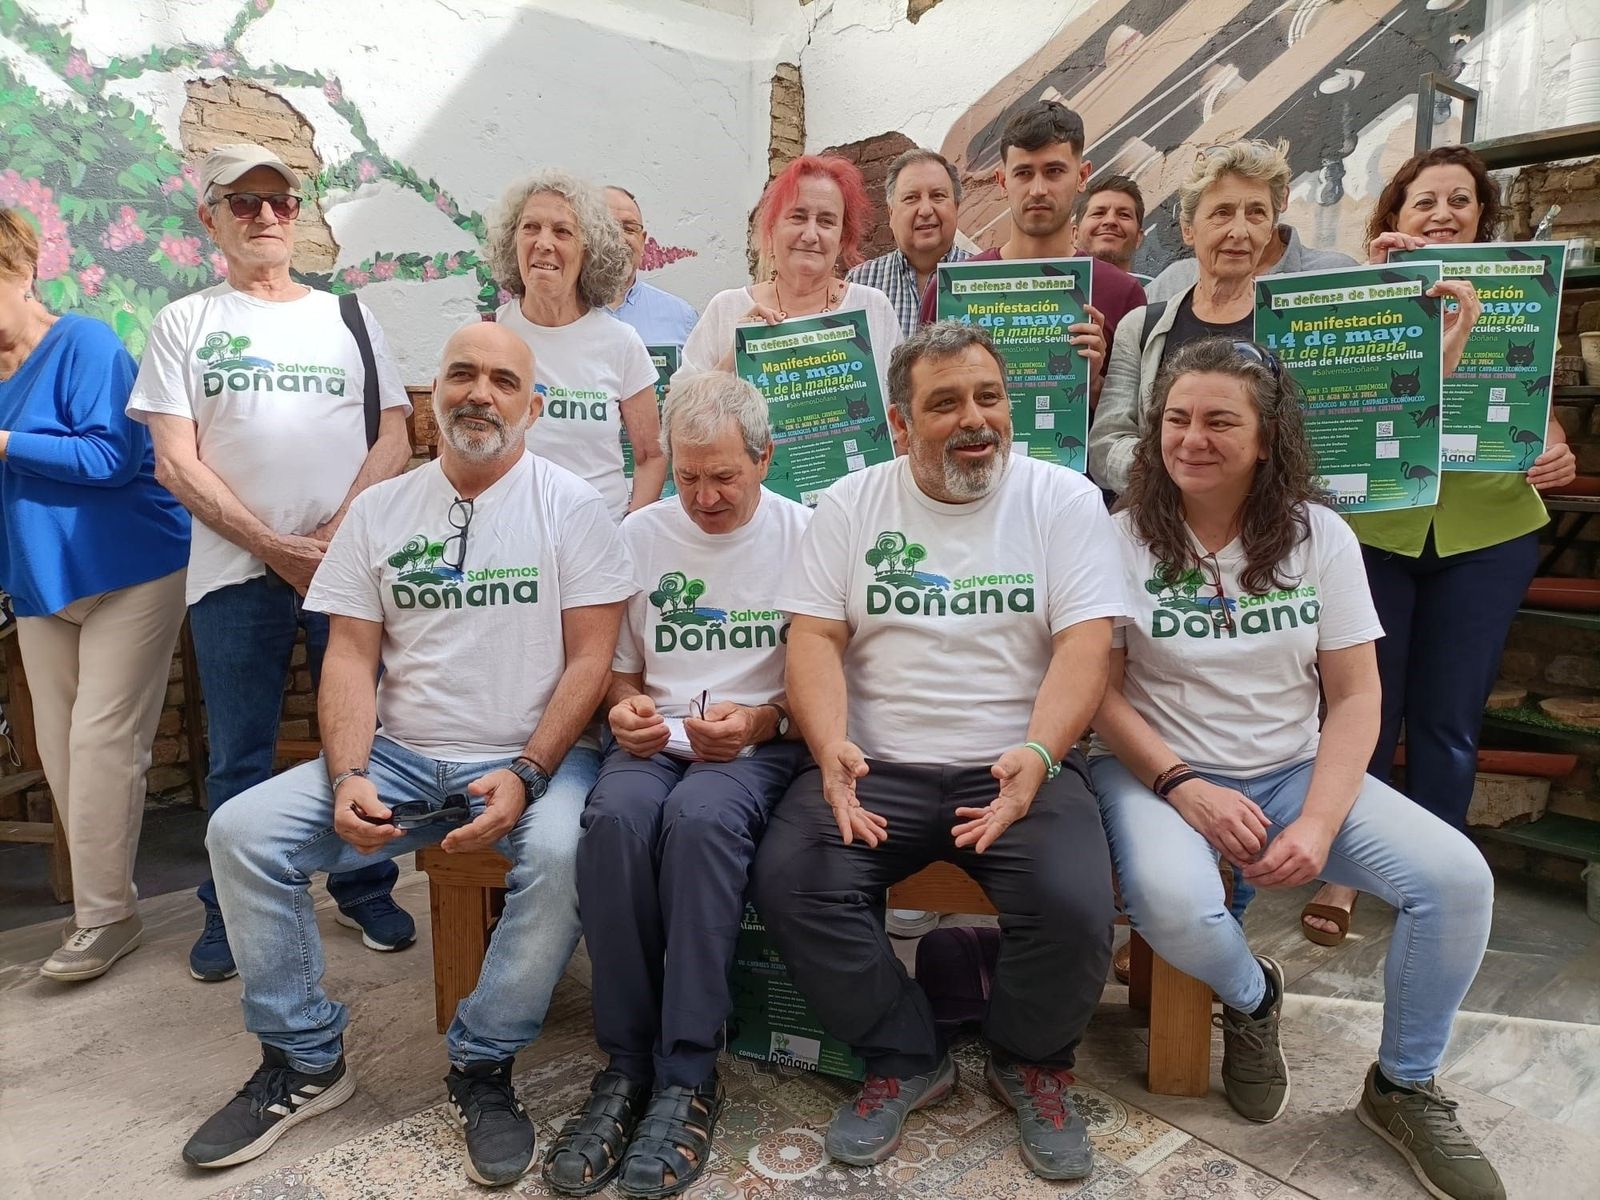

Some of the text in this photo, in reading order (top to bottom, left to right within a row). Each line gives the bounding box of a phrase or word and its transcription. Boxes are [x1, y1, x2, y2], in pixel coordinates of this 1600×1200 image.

[1442, 262, 1542, 274] ensa de Doñana
[954, 278, 1074, 293] En defensa de Doñana
[1274, 285, 1421, 308] En defensa de Doñana
[967, 299, 1060, 315] Manifestación
[978, 313, 1006, 327] de
[1011, 312, 1075, 328] mayo
[1290, 310, 1402, 332] Manifestación
[1476, 312, 1526, 325] añana
[993, 324, 1062, 338] la mañana
[1266, 325, 1424, 349] 14 de mayo
[1470, 324, 1540, 334] rcules-Sevilla
[748, 328, 855, 352] En defensa de Doñana
[1279, 340, 1407, 360] 11 de la mañana
[277, 362, 346, 376] Salvemos
[762, 350, 847, 374] Manifestación
[1282, 350, 1424, 370] ameda de Hércules-Sevilla
[775, 370, 800, 384] de
[806, 360, 863, 379] mayo
[1312, 365, 1380, 377] #SalvemosDoñana
[203, 368, 346, 398] Doñana
[549, 386, 608, 400] Salvemos
[766, 380, 868, 404] meda de Hércules-Sevilla
[774, 383, 788, 394] de
[792, 380, 802, 392] la
[805, 374, 854, 391] mañana
[539, 400, 608, 422] ana
[1442, 452, 1476, 463] ñana
[467, 566, 539, 582] Salvemos
[953, 572, 1034, 590] Salvemos
[392, 580, 538, 610] Doñana
[866, 585, 1035, 616] Doñana
[1238, 586, 1317, 609] Salvemos
[1152, 600, 1320, 639] Doñana
[739, 1049, 766, 1060] convoca
[770, 1052, 818, 1072] Doñana
